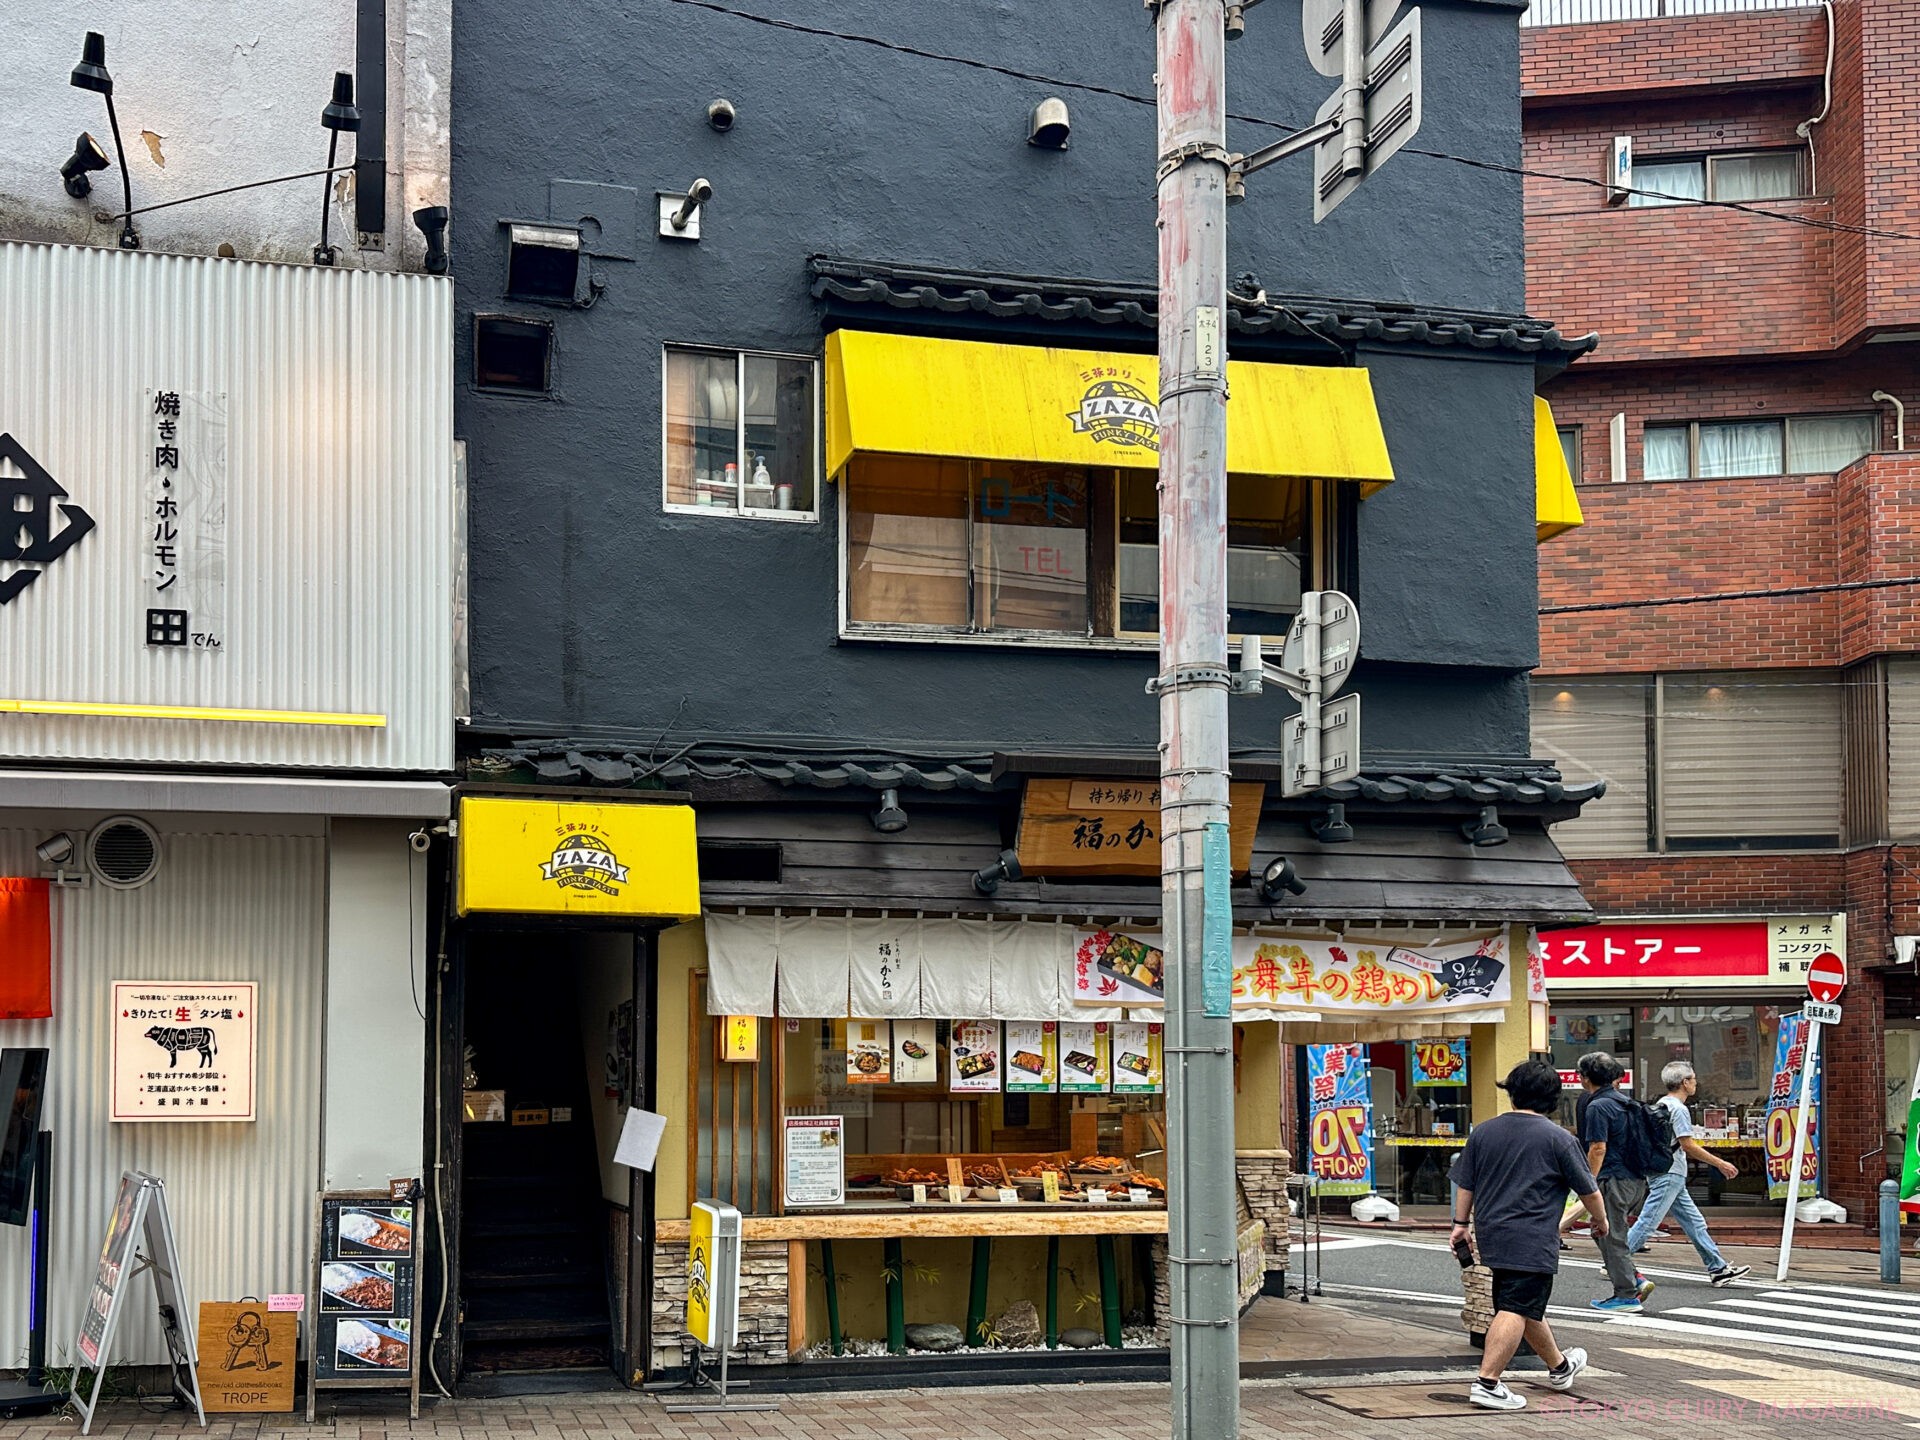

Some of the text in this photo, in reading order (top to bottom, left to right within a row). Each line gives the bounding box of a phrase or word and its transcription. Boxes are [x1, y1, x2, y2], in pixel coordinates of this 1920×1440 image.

[1087, 400, 1155, 423] ZAZA
[1094, 428, 1160, 451] FUNKY TAST
[1019, 547, 1072, 574] TEL
[146, 608, 221, 648] 田 でん
[1088, 787, 1144, 805] 持ち帰り
[556, 851, 613, 870] ZAZA
[559, 874, 617, 896] FUNKY TASTE
[1778, 924, 1833, 935] メガネ
[1778, 942, 1832, 954] コンタクト
[878, 943, 892, 988] 福のから
[175, 1007, 191, 1022] 生
[200, 1008, 233, 1020] タン塩
[1807, 1005, 1838, 1020] 自転車を除く
[1427, 1066, 1452, 1076] OFF
[221, 1392, 269, 1404] TROPE
